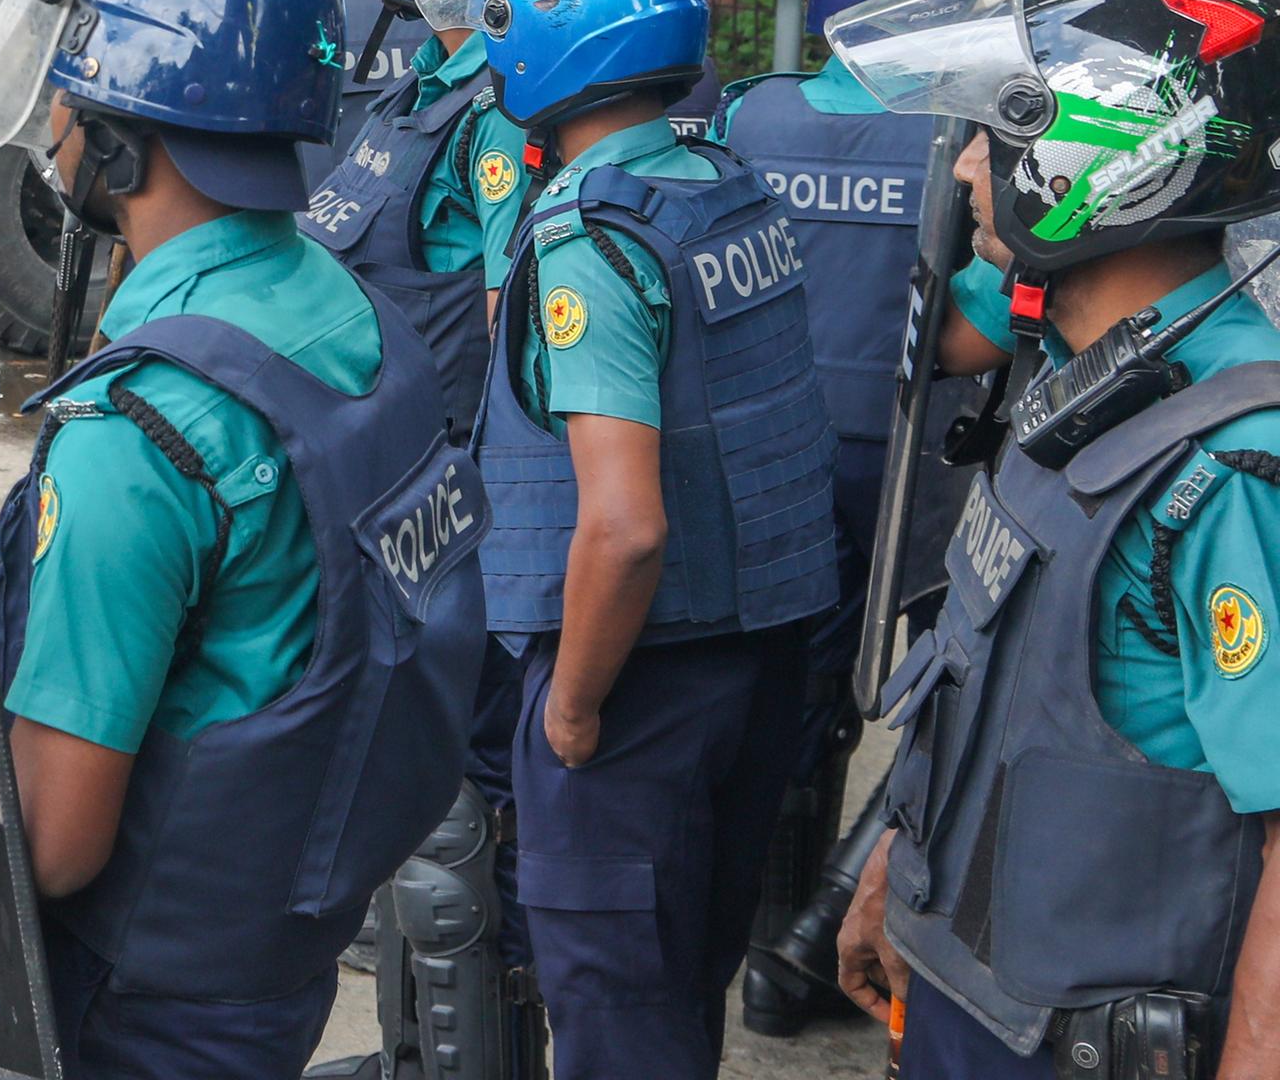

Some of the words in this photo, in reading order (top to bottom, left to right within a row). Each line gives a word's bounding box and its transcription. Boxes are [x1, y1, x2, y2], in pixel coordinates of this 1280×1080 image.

[1088, 94, 1219, 192] SPLITTER
[766, 172, 905, 214] POLICE
[693, 217, 803, 311] POLICE
[380, 464, 474, 600] POLICE
[956, 482, 1025, 603] POLICE
